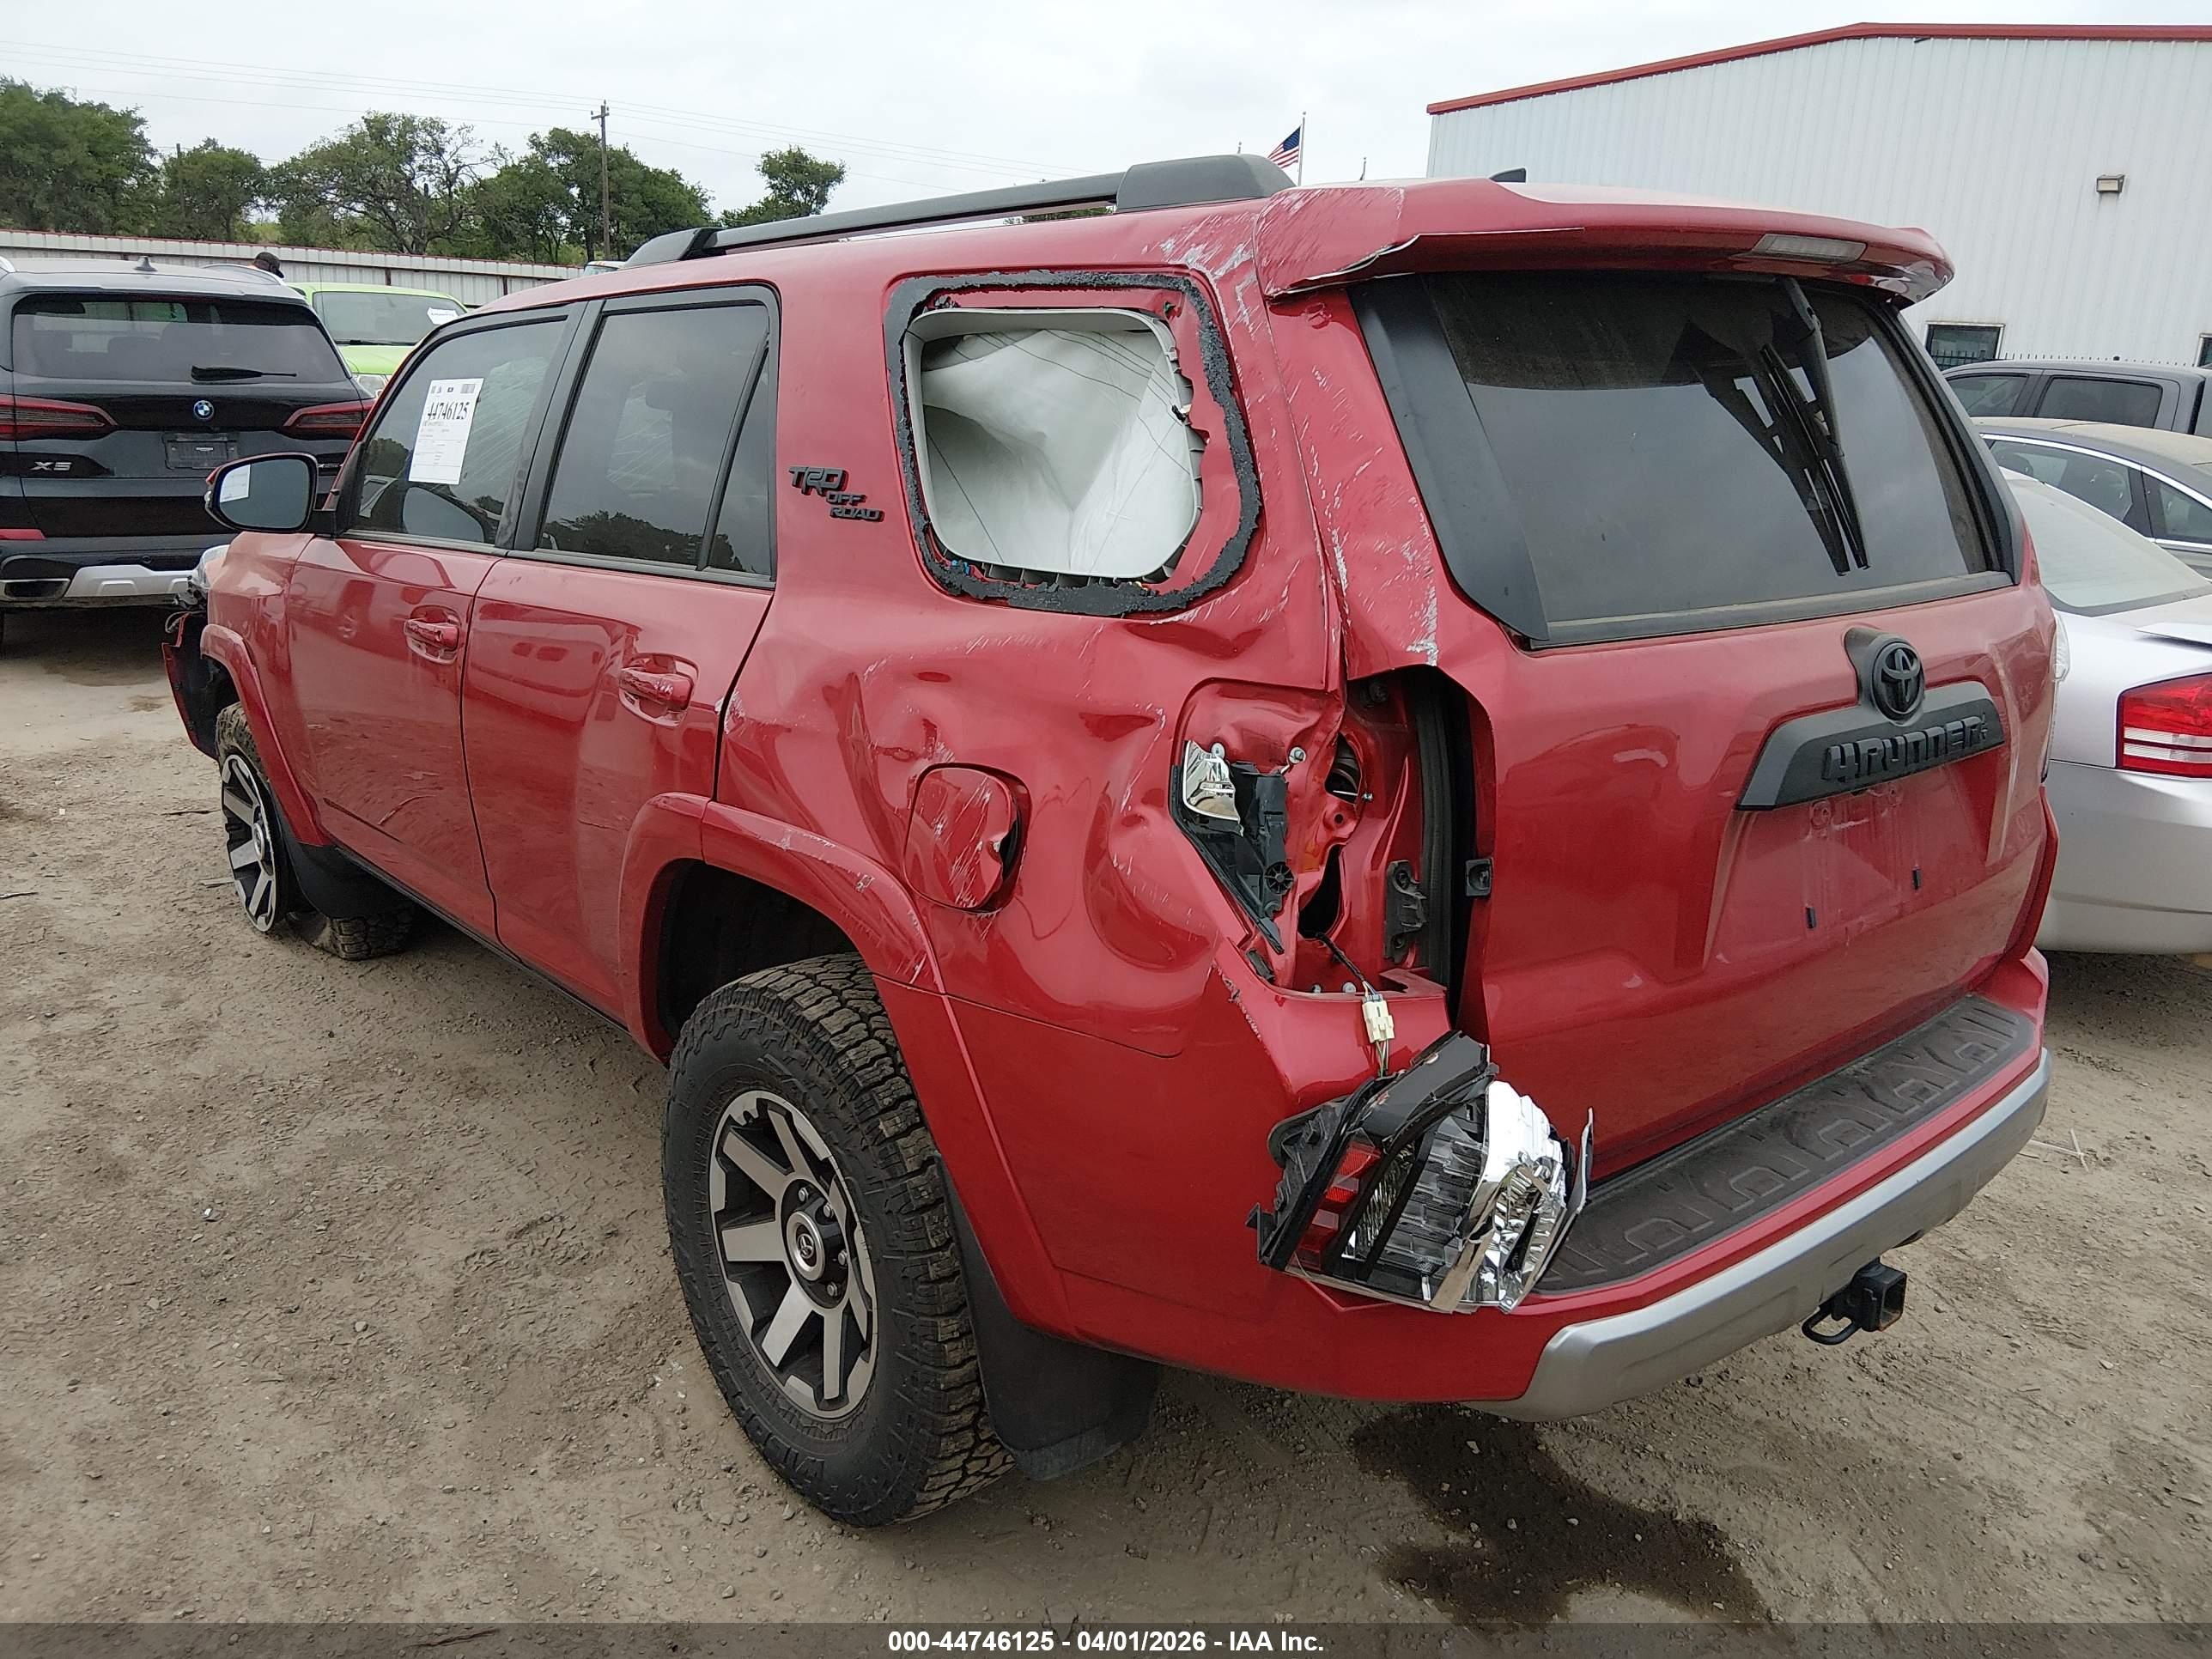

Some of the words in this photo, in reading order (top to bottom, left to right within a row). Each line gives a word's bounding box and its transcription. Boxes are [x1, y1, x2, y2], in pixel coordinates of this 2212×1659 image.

[428, 401, 470, 420] 44746125
[29, 461, 72, 471] X5
[789, 466, 848, 496] TRD
[826, 490, 867, 506] OFF
[830, 506, 885, 522] ROAD
